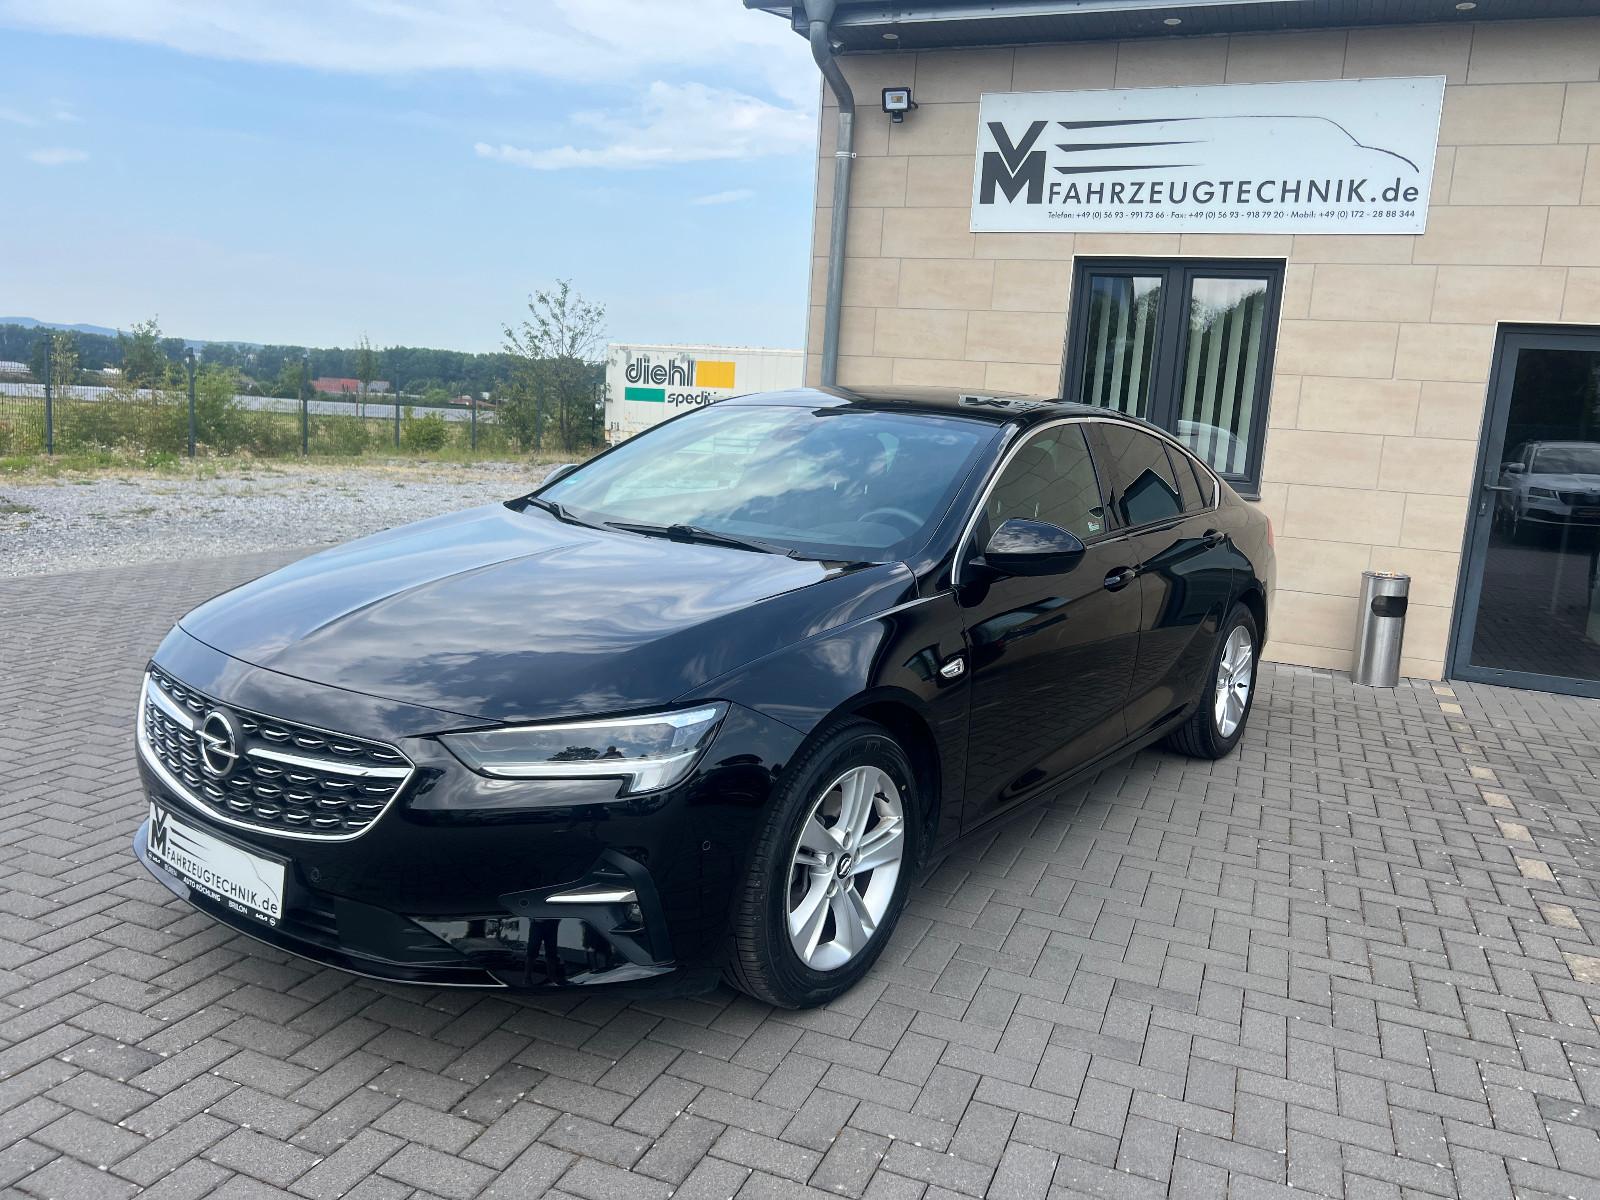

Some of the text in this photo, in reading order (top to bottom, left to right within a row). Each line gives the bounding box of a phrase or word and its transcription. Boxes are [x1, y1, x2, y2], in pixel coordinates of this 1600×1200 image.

[1048, 177, 1419, 204] FAHRZEUGTECHNIK.de
[1076, 211, 1091, 219] +49
[1092, 211, 1102, 220] (0)
[1103, 211, 1113, 219] 56
[1114, 211, 1124, 219] 93
[1130, 211, 1143, 219] 991
[1144, 211, 1154, 219] 73
[1155, 211, 1165, 219] 66
[1188, 211, 1204, 219] +49
[1205, 211, 1216, 220] (0)
[1217, 211, 1227, 219] 56
[1229, 211, 1239, 219] 93
[1246, 211, 1260, 219] 918
[1261, 211, 1272, 219] 79
[1273, 211, 1284, 219] 20
[1290, 211, 1316, 219] Mobil:
[1319, 210, 1335, 218] +49
[1337, 210, 1348, 219] (0)
[1351, 210, 1364, 218] 172
[1372, 210, 1383, 218] 28
[1385, 210, 1397, 218] 88
[1399, 210, 1415, 218] 344
[625, 358, 694, 387] diehl
[167, 846, 279, 914] FAHRZEUGTECHNIK.de
